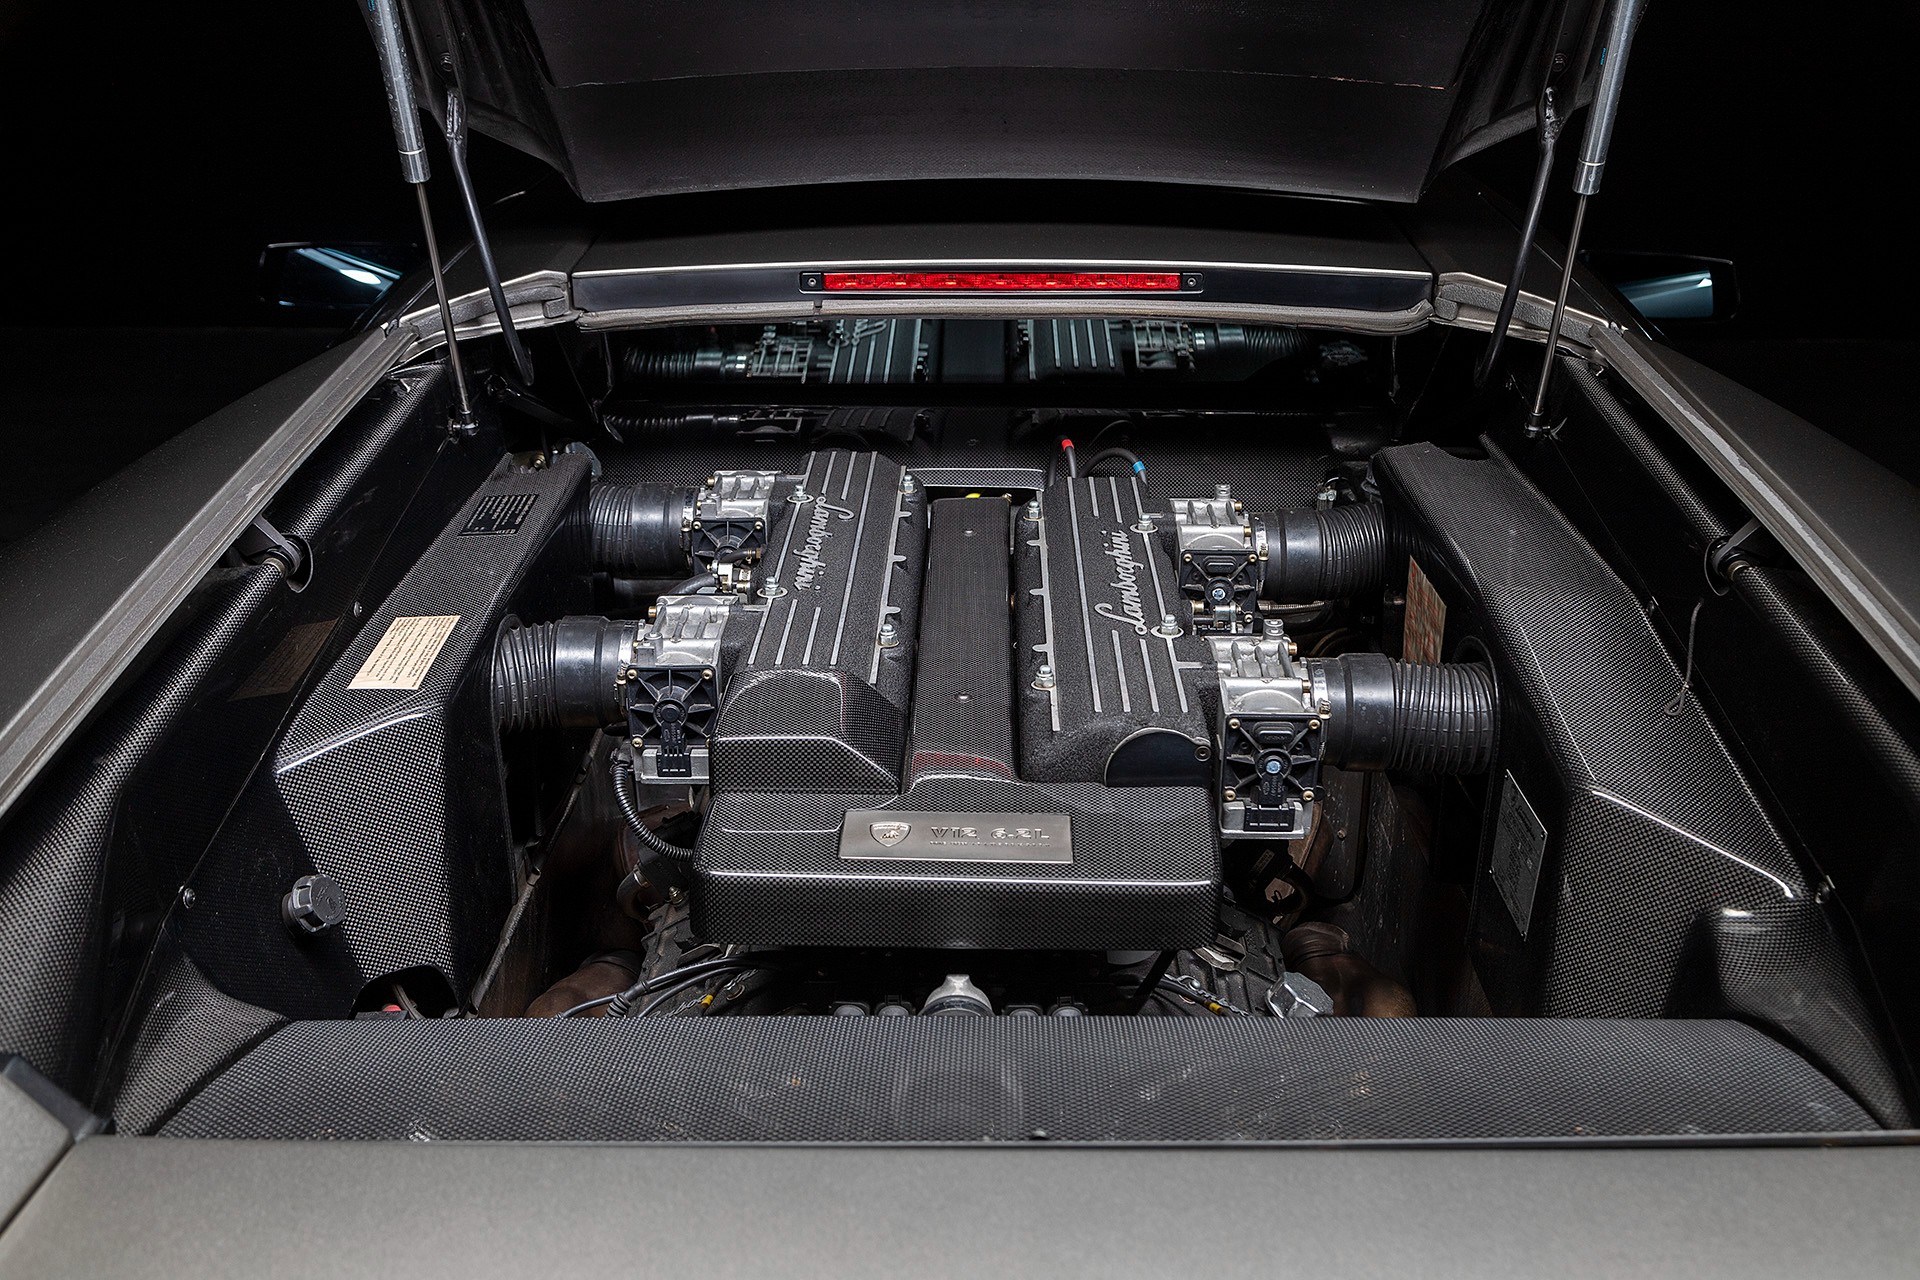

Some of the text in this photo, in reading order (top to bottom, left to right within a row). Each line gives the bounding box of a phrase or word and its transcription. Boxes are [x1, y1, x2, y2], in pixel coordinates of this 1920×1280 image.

[793, 496, 855, 591] Lamborghini
[1094, 530, 1148, 635] Lamborghini
[930, 826, 1050, 839] V12 6.2L
